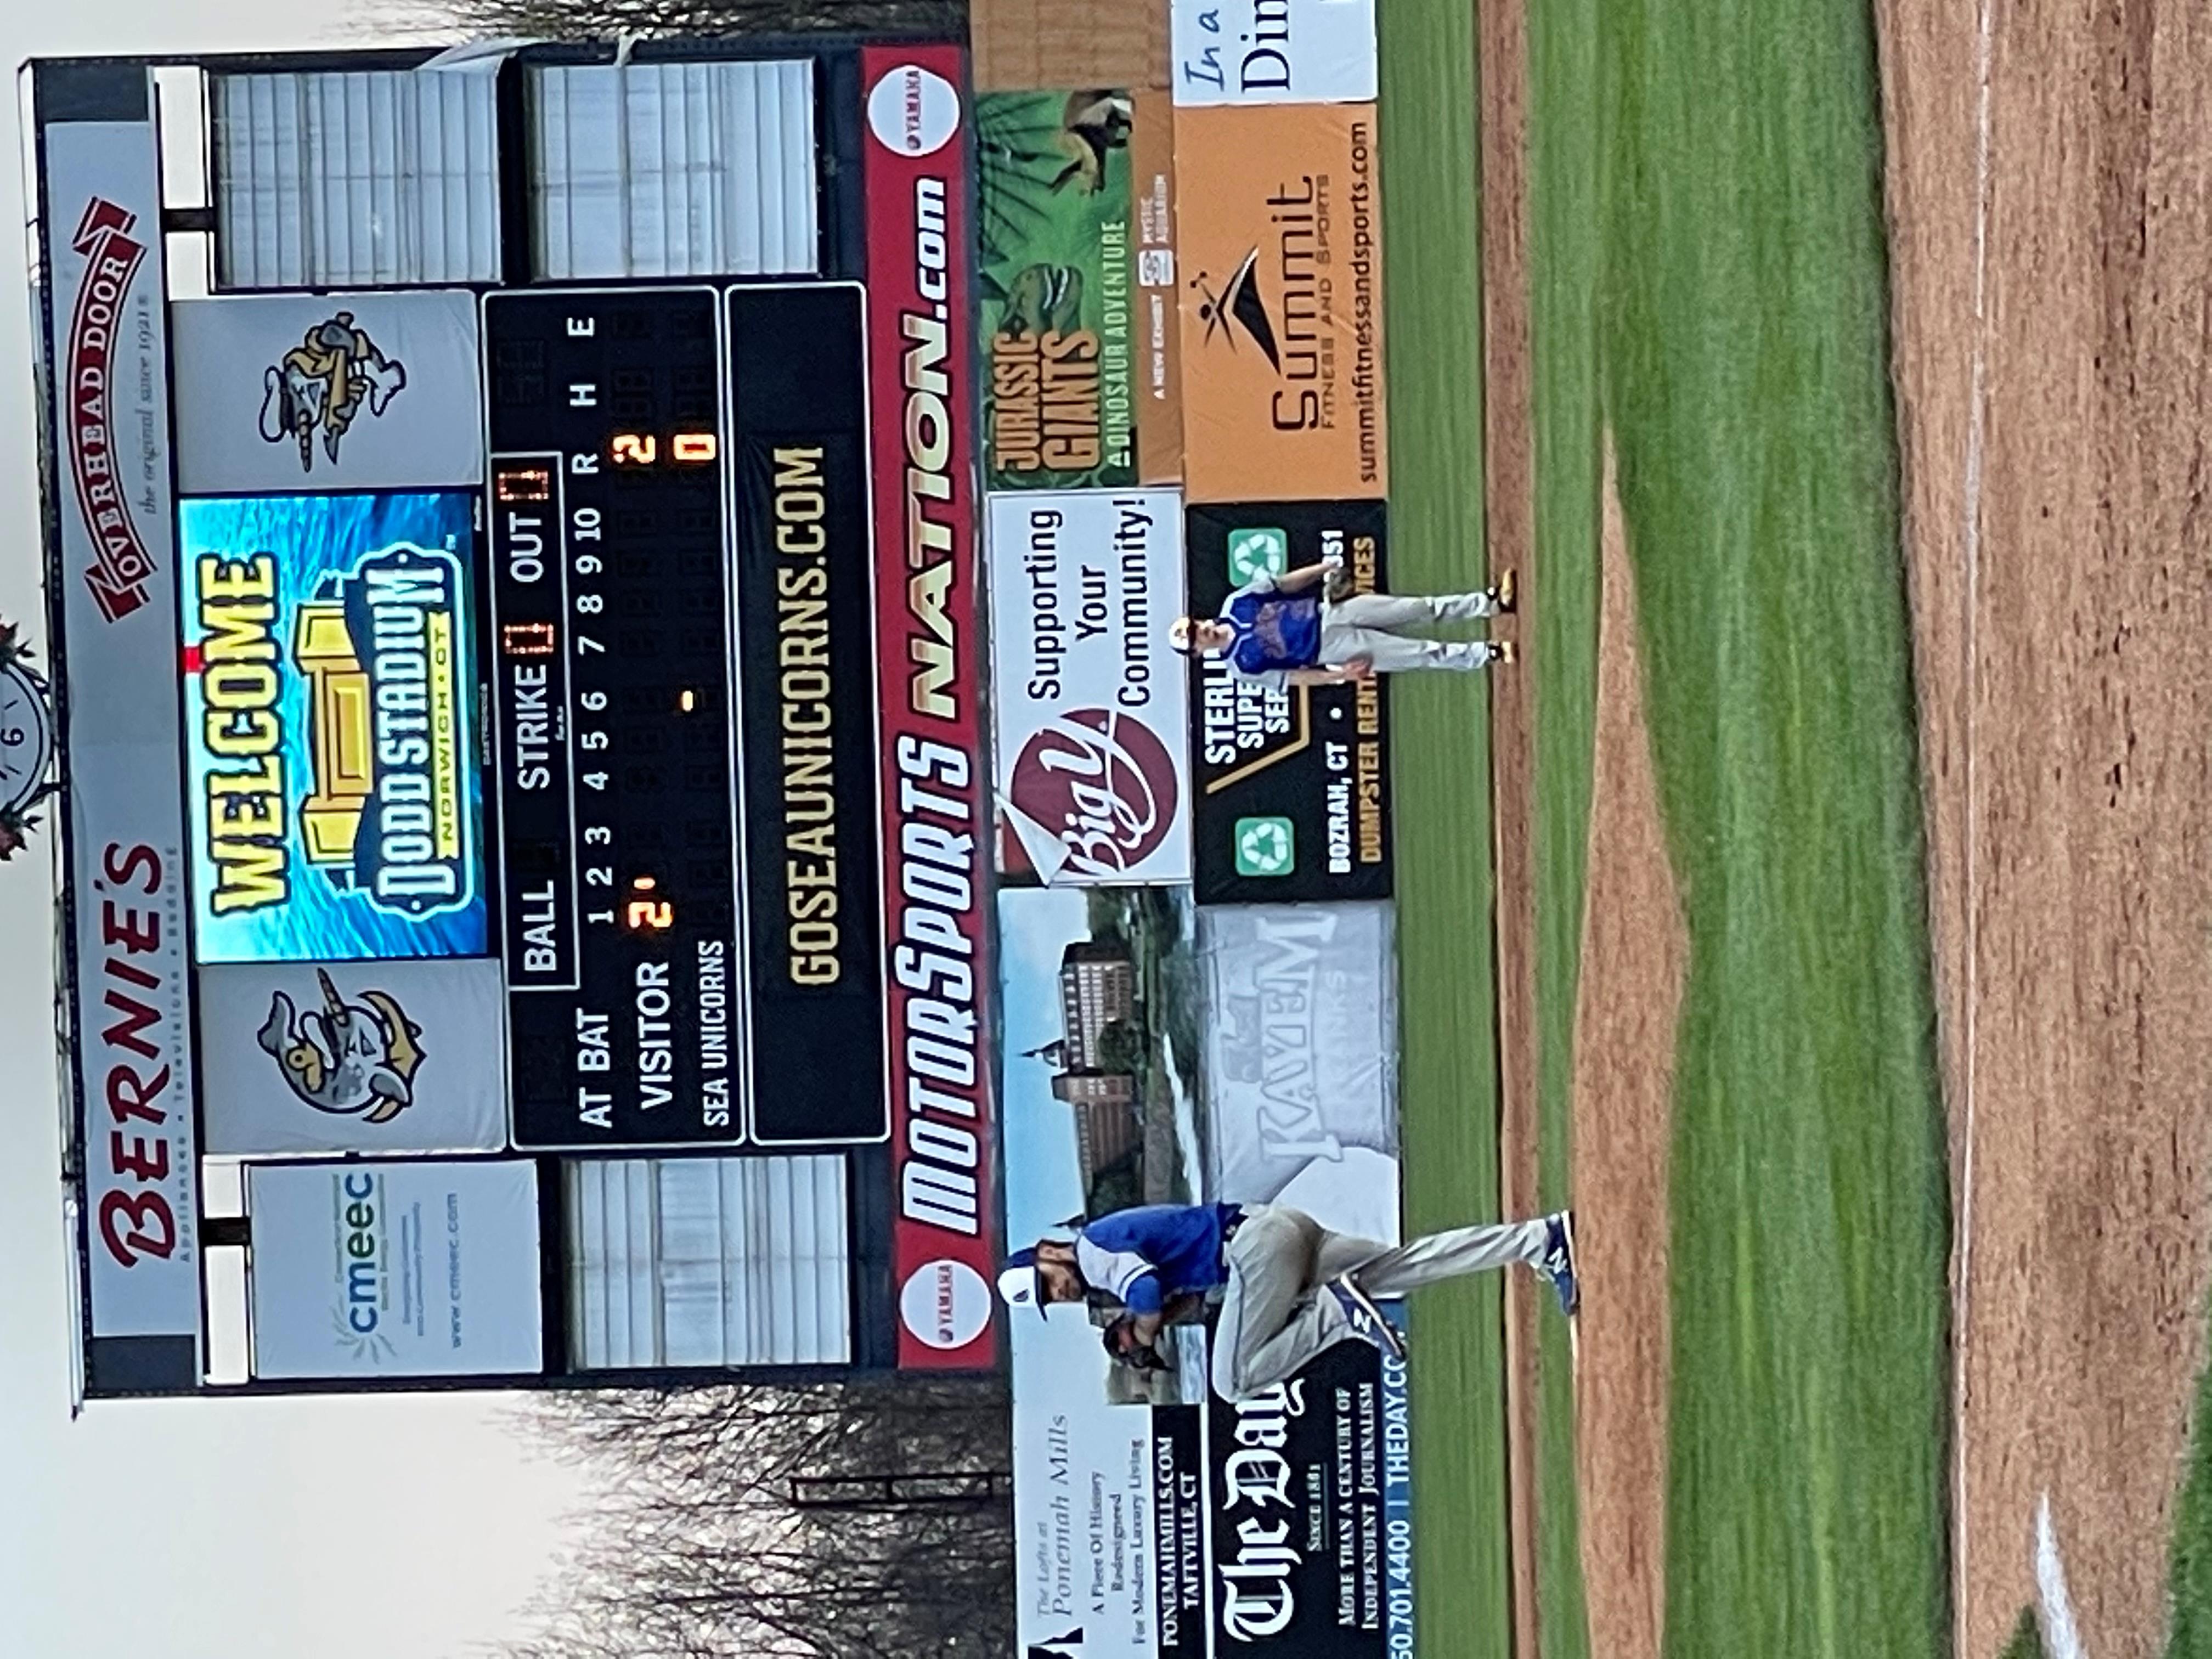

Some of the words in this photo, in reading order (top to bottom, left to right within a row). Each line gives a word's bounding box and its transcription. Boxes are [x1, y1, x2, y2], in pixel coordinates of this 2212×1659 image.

[1198, 8, 1221, 34] a
[1184, 46, 1225, 92] In
[905, 69, 923, 134] YAMAHA
[83, 257, 128, 351] DOOR
[1102, 221, 1128, 337] ADVENTURE
[1265, 176, 1318, 431] Summit
[1318, 278, 1334, 326] AND
[1348, 122, 1379, 483] summitfitnessandsports.com
[567, 317, 595, 336] E
[138, 357, 152, 403] since
[569, 383, 596, 407] H
[992, 331, 1041, 471] JURASSIC
[1042, 330, 1101, 469] GIANTS
[1105, 344, 1130, 447] DINOSAUR
[80, 366, 142, 577] OVERHEAD
[135, 409, 160, 480] original
[572, 453, 599, 474] R
[612, 434, 656, 464] 2
[673, 433, 716, 460] 0
[902, 178, 957, 720] NATION.com
[137, 487, 156, 514] the
[574, 507, 601, 541] 10
[509, 511, 544, 582] OUT
[575, 555, 602, 574] 9
[577, 594, 603, 614] 8
[1025, 510, 1066, 700] Supporting
[1074, 563, 1108, 640] Your
[1113, 499, 1153, 707] Community!
[366, 567, 445, 765] STADIUM
[433, 625, 449, 666] CT
[578, 635, 605, 655] 7
[580, 692, 607, 712] 6
[774, 447, 840, 985] GOSEAUNICORNS.COM
[1204, 620, 1235, 764] STERLI
[0, 728, 24, 747] 6
[200, 555, 287, 914] WELCOME
[515, 664, 550, 789] STRIKE
[582, 731, 608, 750] 5
[1327, 741, 1348, 770] CT
[436, 690, 453, 842] NORWICH
[583, 771, 609, 790] 4
[1062, 781, 1143, 876] Big
[1329, 778, 1353, 873] BOZRAH,
[1357, 742, 1381, 862] DUMPSTER
[377, 774, 456, 896] DODD
[584, 826, 611, 845] 3
[585, 866, 613, 886] 2
[521, 879, 557, 972] BALL
[588, 910, 614, 924] 1
[628, 900, 674, 929] 2
[636, 962, 673, 1109] VISITOR
[698, 940, 727, 1069] UNICORNS
[93, 843, 176, 1268] BERNIE'S
[576, 1007, 611, 1071] BAT
[1253, 913, 1344, 1163] KAYEM
[579, 1086, 612, 1128] AT
[702, 1077, 730, 1126] SEA
[345, 1173, 378, 1333] cmeec
[936, 1263, 955, 1325] YAMAHA
[1335, 1387, 1352, 1412] OF
[1383, 1331, 1410, 1487] THEDAY.CO
[1047, 1414, 1069, 1485] Mills
[1128, 1439, 1145, 1489] Living
[1337, 1415, 1353, 1498] CENTURY
[1089, 1471, 1105, 1529] History
[1180, 1471, 1196, 1498] CT
[1338, 1501, 1353, 1515] A
[1090, 1533, 1103, 1554] Of
[1129, 1494, 1146, 1548] Luxury
[1158, 1436, 1179, 1646] PONEMAHMILLS.COM
[1338, 1518, 1355, 1568] THAN
[1036, 1543, 1052, 1582] Lofts
[1050, 1496, 1073, 1616] Ponemah
[1091, 1558, 1104, 1597] Piece
[1131, 1554, 1145, 1615] Modern
[1180, 1502, 1200, 1610] TAFTVILLE,
[1217, 1516, 1303, 1641] The
[1037, 1591, 1050, 1617] The
[1092, 1603, 1104, 1615] A
